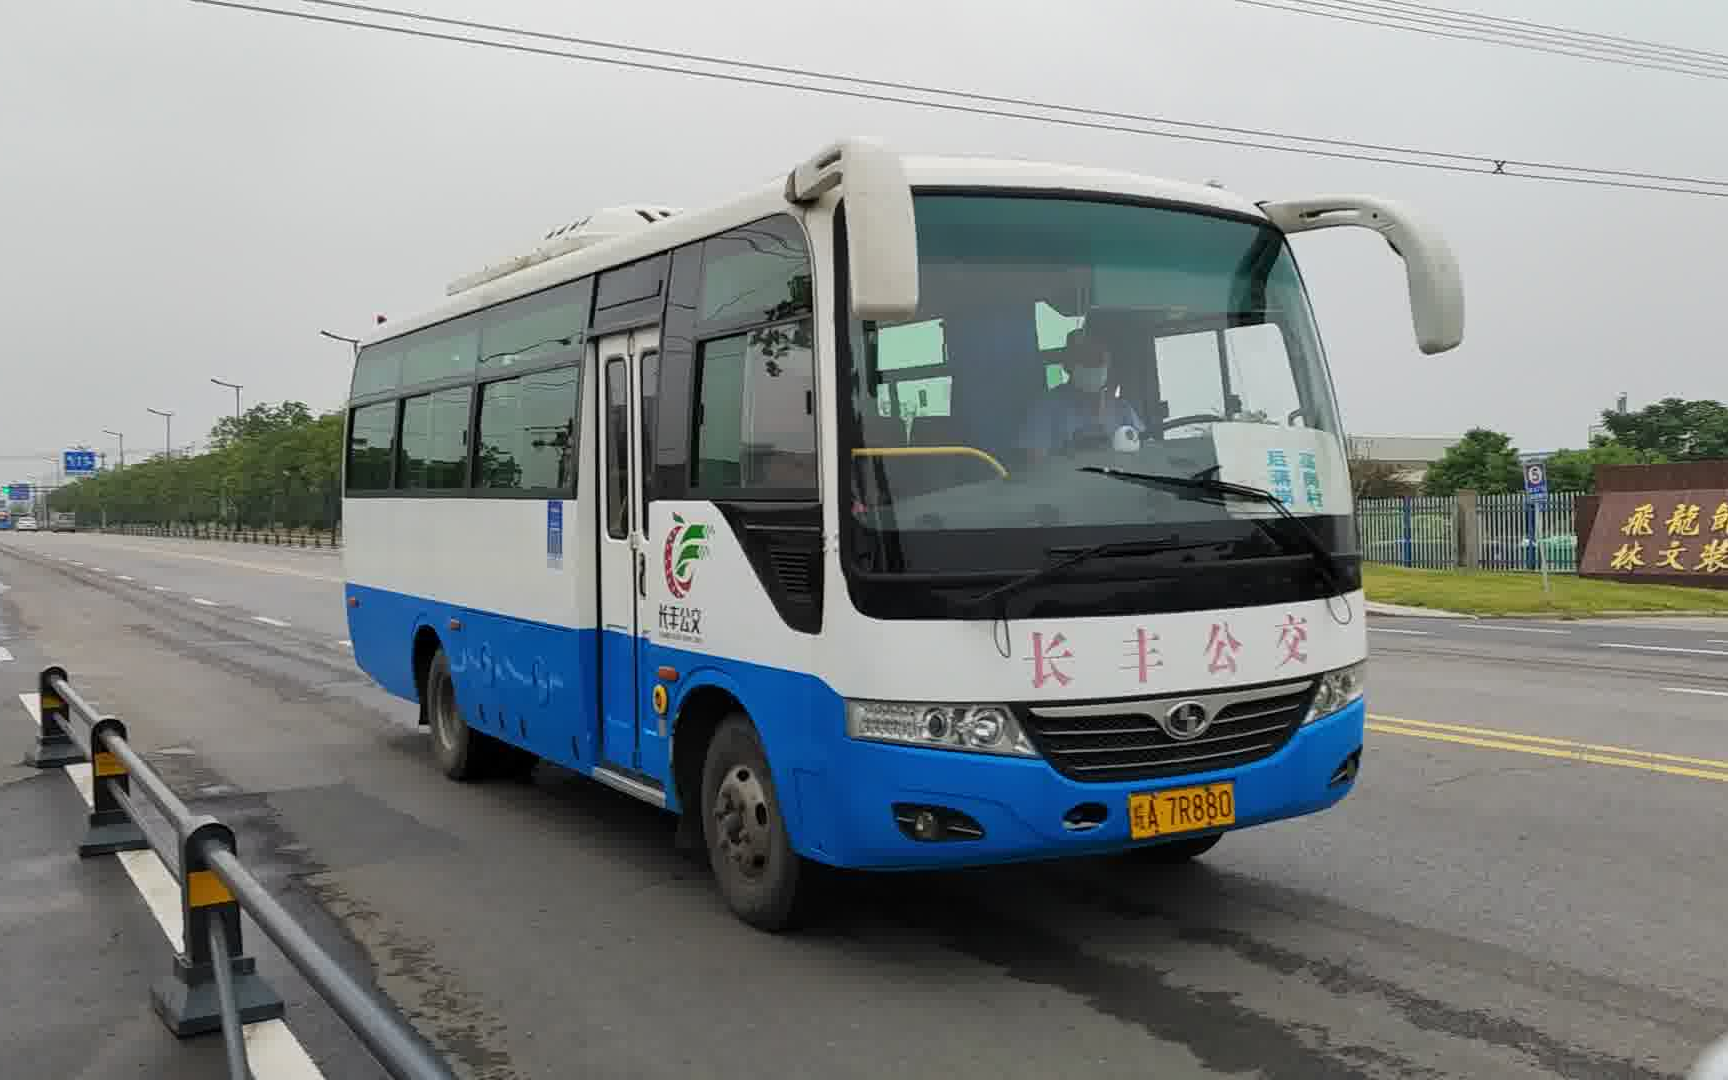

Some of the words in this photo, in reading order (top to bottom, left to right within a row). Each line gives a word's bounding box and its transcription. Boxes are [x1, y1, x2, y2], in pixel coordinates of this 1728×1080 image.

[659, 603, 701, 634] 长丰公交
[1023, 614, 1308, 689] 长丰公交
